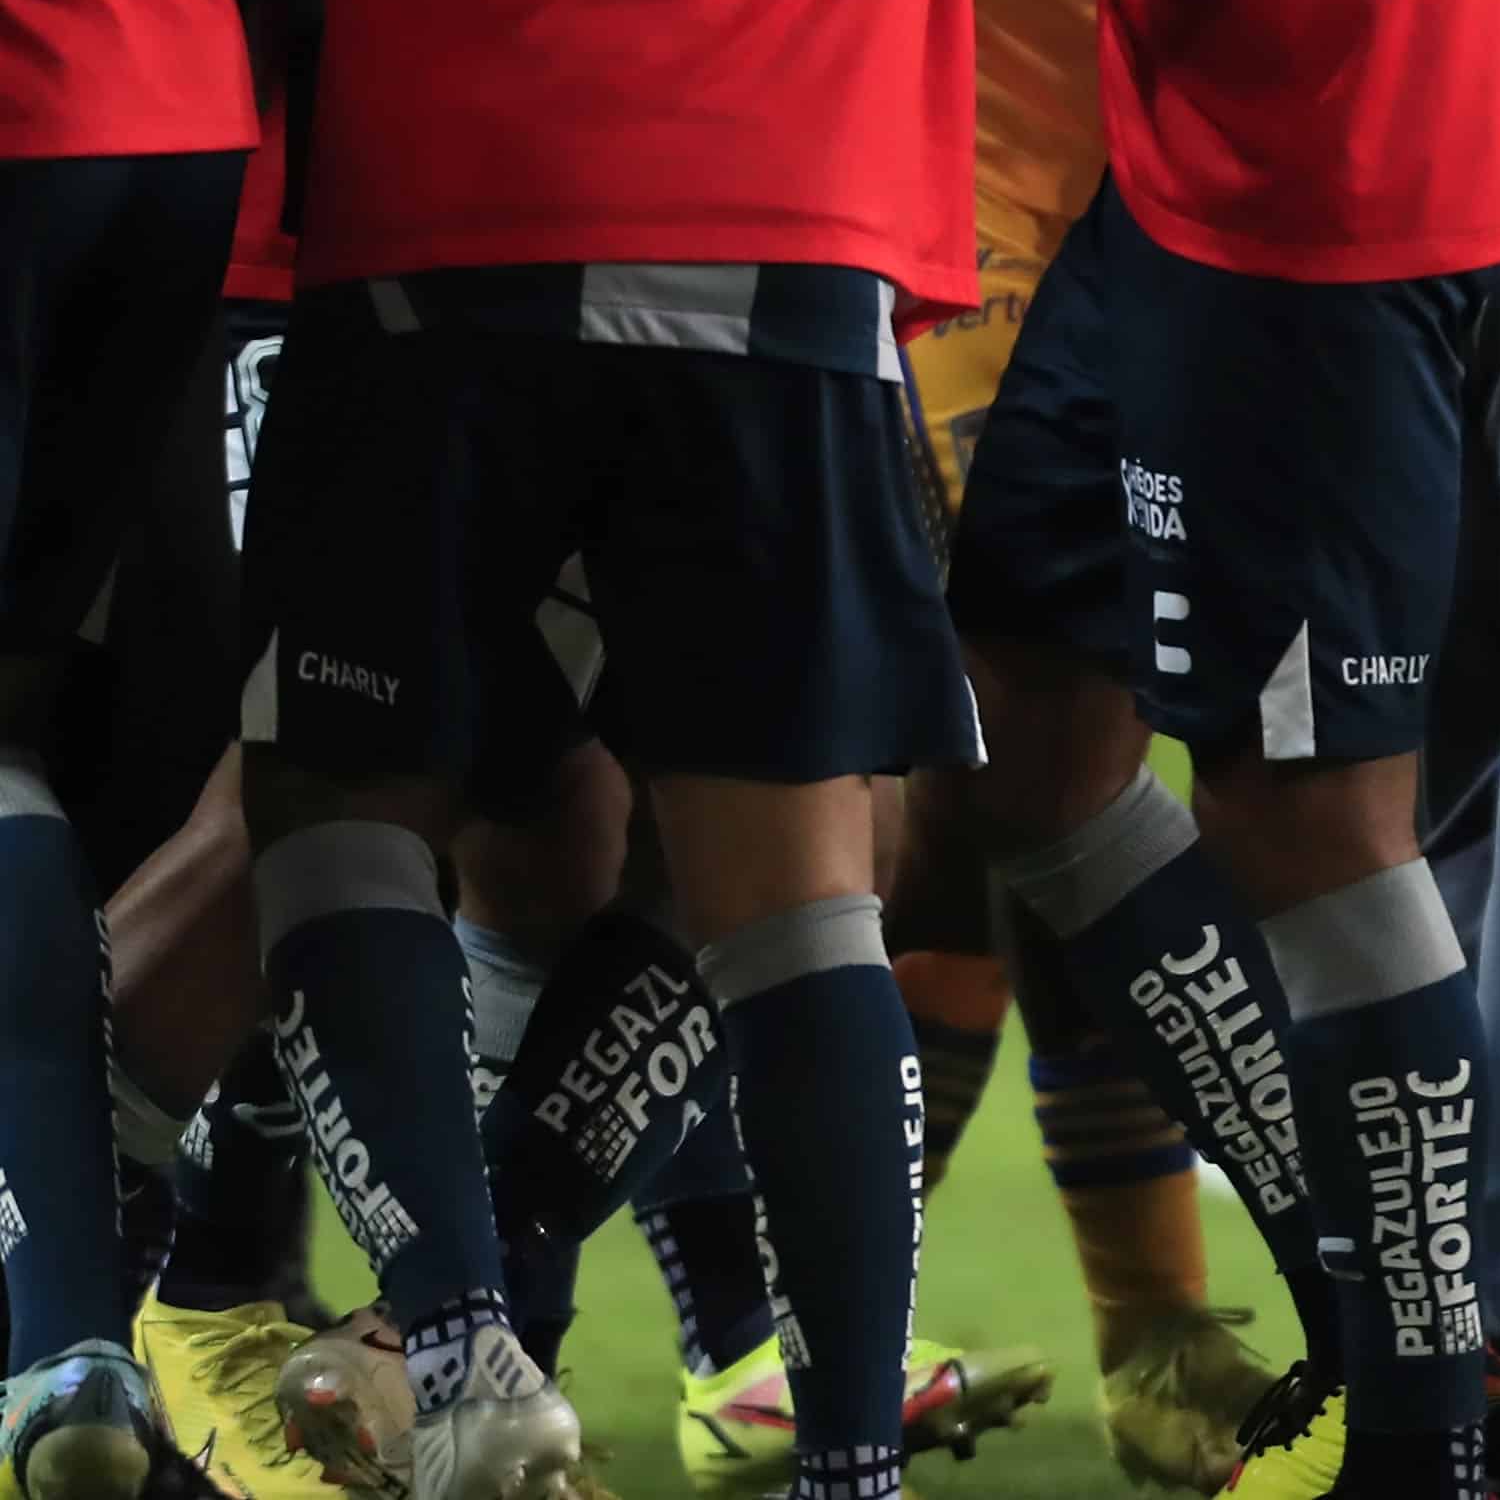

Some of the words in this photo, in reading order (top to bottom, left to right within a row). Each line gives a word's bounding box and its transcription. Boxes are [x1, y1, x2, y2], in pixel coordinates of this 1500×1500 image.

[299, 651, 400, 706] CHARLY
[1341, 653, 1430, 686] CHARLY
[1130, 968, 1296, 1216] PEGAZULEJO
[1350, 1075, 1434, 1357] PEGAZULEJO
[1406, 1058, 1475, 1308] FORTEC
